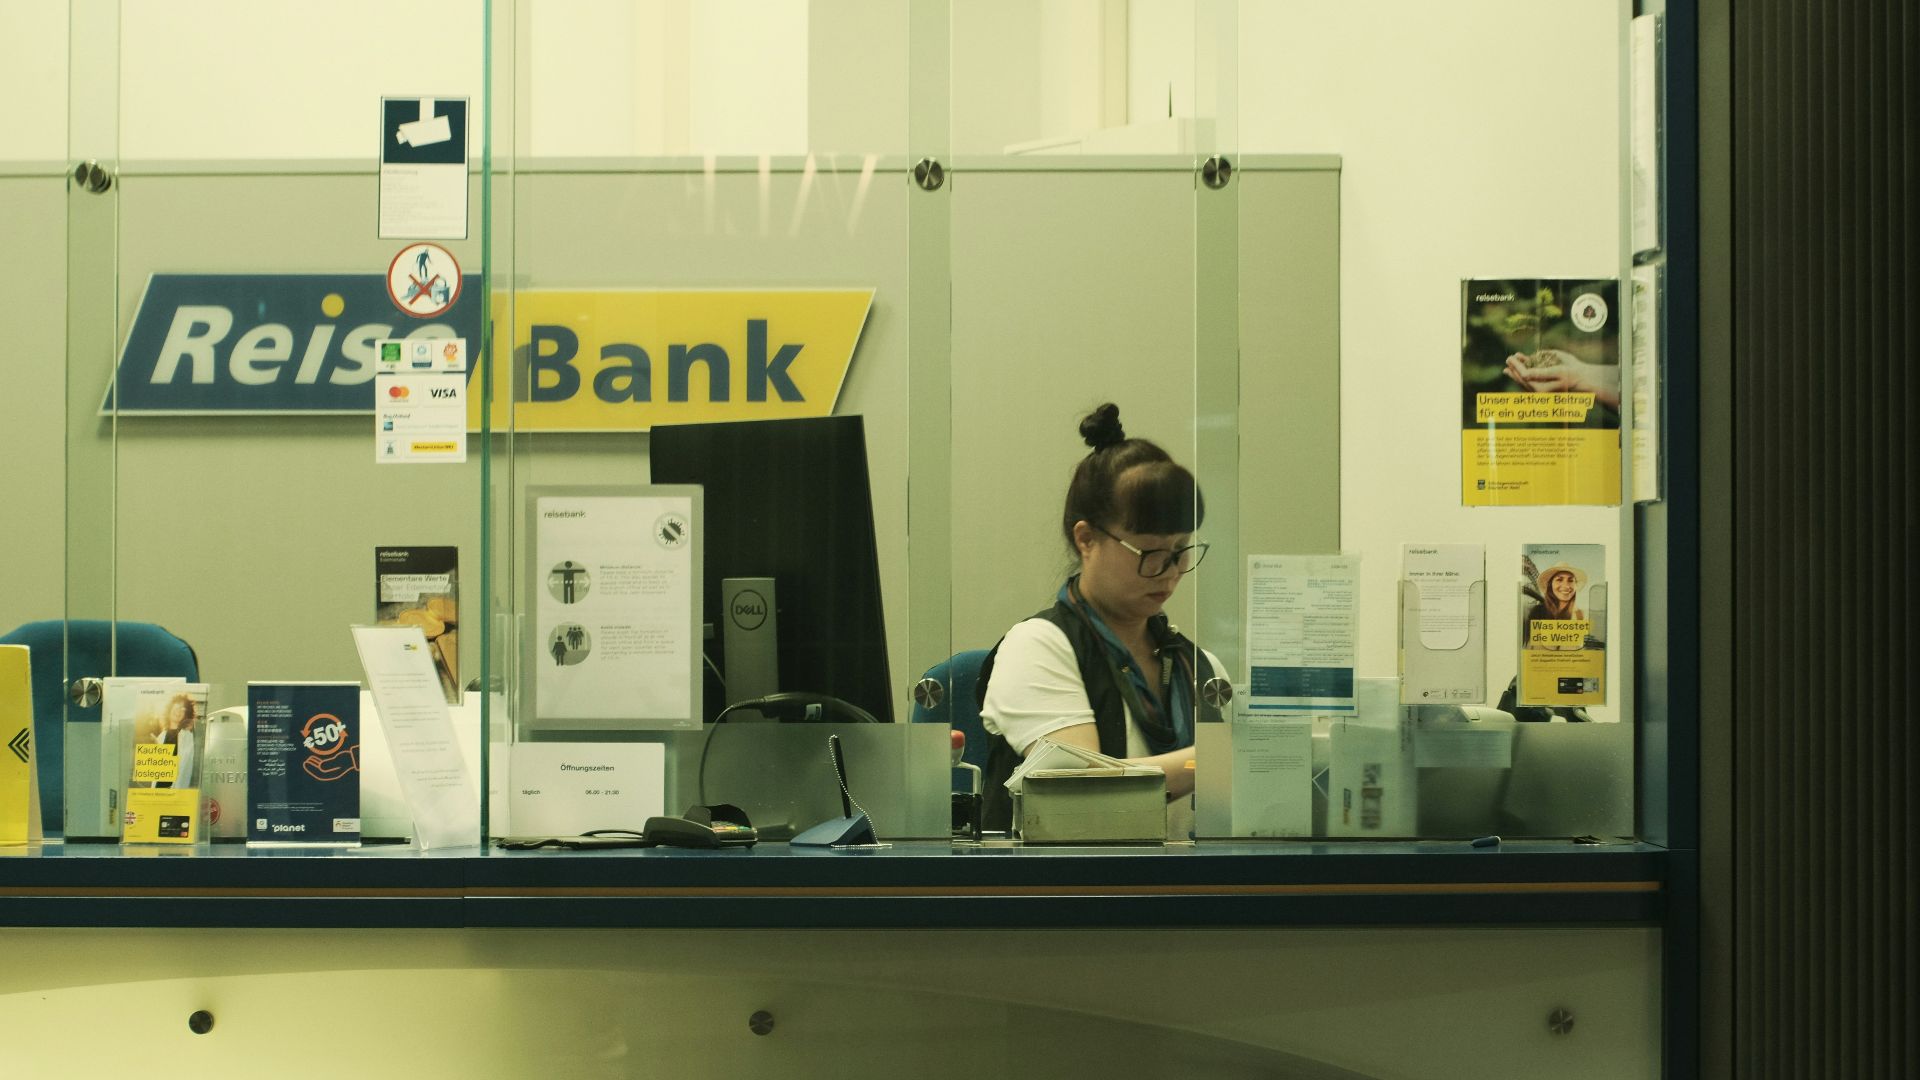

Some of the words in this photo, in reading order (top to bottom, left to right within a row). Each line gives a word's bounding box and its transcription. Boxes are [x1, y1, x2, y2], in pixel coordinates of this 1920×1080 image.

[150, 294, 458, 385] Reis
[531, 319, 805, 403] Bank
[431, 388, 457, 398] VISA
[1479, 395, 1510, 405] Unser
[1513, 395, 1550, 405] aktiver
[1554, 395, 1592, 407] Beitrag
[1480, 408, 1494, 417] für
[1498, 408, 1514, 417] ein
[1517, 409, 1548, 419] gutes
[1552, 408, 1583, 417] Klima.
[544, 510, 586, 519] reisebank
[735, 604, 763, 615] DELL
[1532, 621, 1553, 630] Was
[1557, 621, 1589, 630] kostet
[1532, 633, 1547, 641] die
[1551, 633, 1580, 641] Welt?
[137, 746, 171, 756] Kaufen,
[136, 757, 177, 768] aufladen,
[560, 762, 615, 773] Öffnungszeiten
[135, 769, 174, 780] loslegen!
[273, 824, 306, 833] planet
